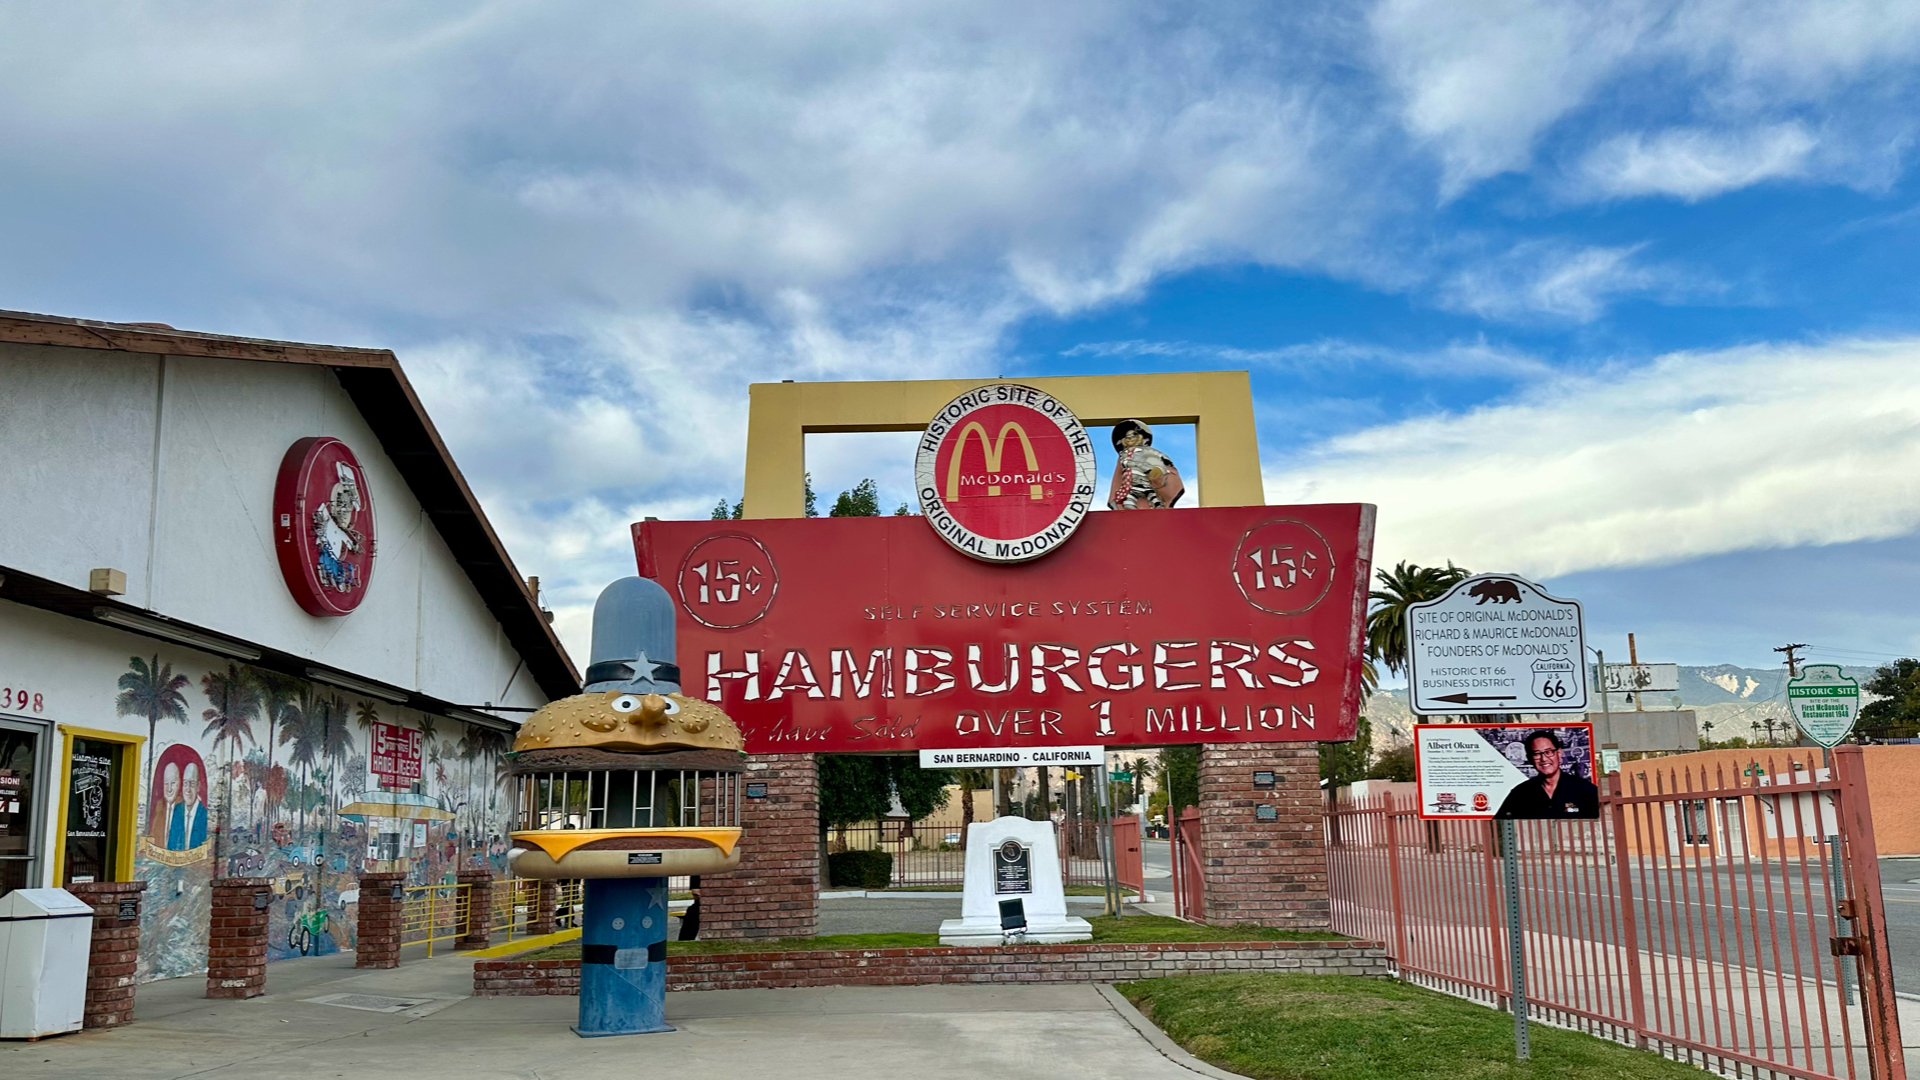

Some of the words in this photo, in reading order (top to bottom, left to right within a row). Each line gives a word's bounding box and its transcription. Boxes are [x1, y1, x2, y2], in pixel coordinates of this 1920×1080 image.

[922, 389, 991, 452] HISTORIC
[996, 386, 1038, 405] SITE
[1041, 399, 1068, 419] OF
[1063, 418, 1090, 455] THE
[960, 472, 1066, 486] McDonald's
[921, 487, 987, 554] ORIGINAL
[995, 484, 1092, 557] McDONALD'S
[863, 603, 923, 621] SELF
[933, 601, 1041, 619] SERVICE
[1050, 599, 1153, 616] SYSTEM
[1418, 612, 1438, 624] SITE
[1440, 611, 1455, 623] OF
[1457, 610, 1506, 623] ORIGINAL
[1507, 609, 1574, 622] McDONALD'S
[1415, 628, 1461, 641] RICHARD
[1464, 628, 1470, 640] &
[1472, 627, 1518, 640] MAURICE
[1520, 626, 1578, 639] McDONALD
[1427, 645, 1483, 658] FOUNDERS
[1485, 644, 1500, 657] OF
[1502, 643, 1569, 657] McDONALD'S
[705, 639, 1321, 702] HAMBURGERS
[1431, 667, 1477, 676] HISTORIC
[1479, 666, 1491, 675] RT
[1494, 666, 1507, 675] 66
[1536, 662, 1570, 671] CALIFORNIA
[1422, 679, 1470, 688] BUSINESS
[1471, 678, 1516, 687] DISTRICT
[1543, 679, 1566, 698] 66
[1789, 687, 1834, 696] HISTORIC
[1837, 687, 1857, 695] SITE
[1801, 704, 1815, 712] First
[1802, 711, 1835, 719] Restaurant
[768, 715, 833, 742] have
[846, 714, 922, 741] Sold
[954, 708, 1064, 736] OVER
[1089, 699, 1116, 737] 1
[1145, 703, 1316, 733] MILLION
[1453, 741, 1480, 749] Okura
[933, 754, 954, 764] SAN
[956, 752, 1020, 763] BERNARDINO
[1032, 751, 1092, 762] CALIFORNIA
